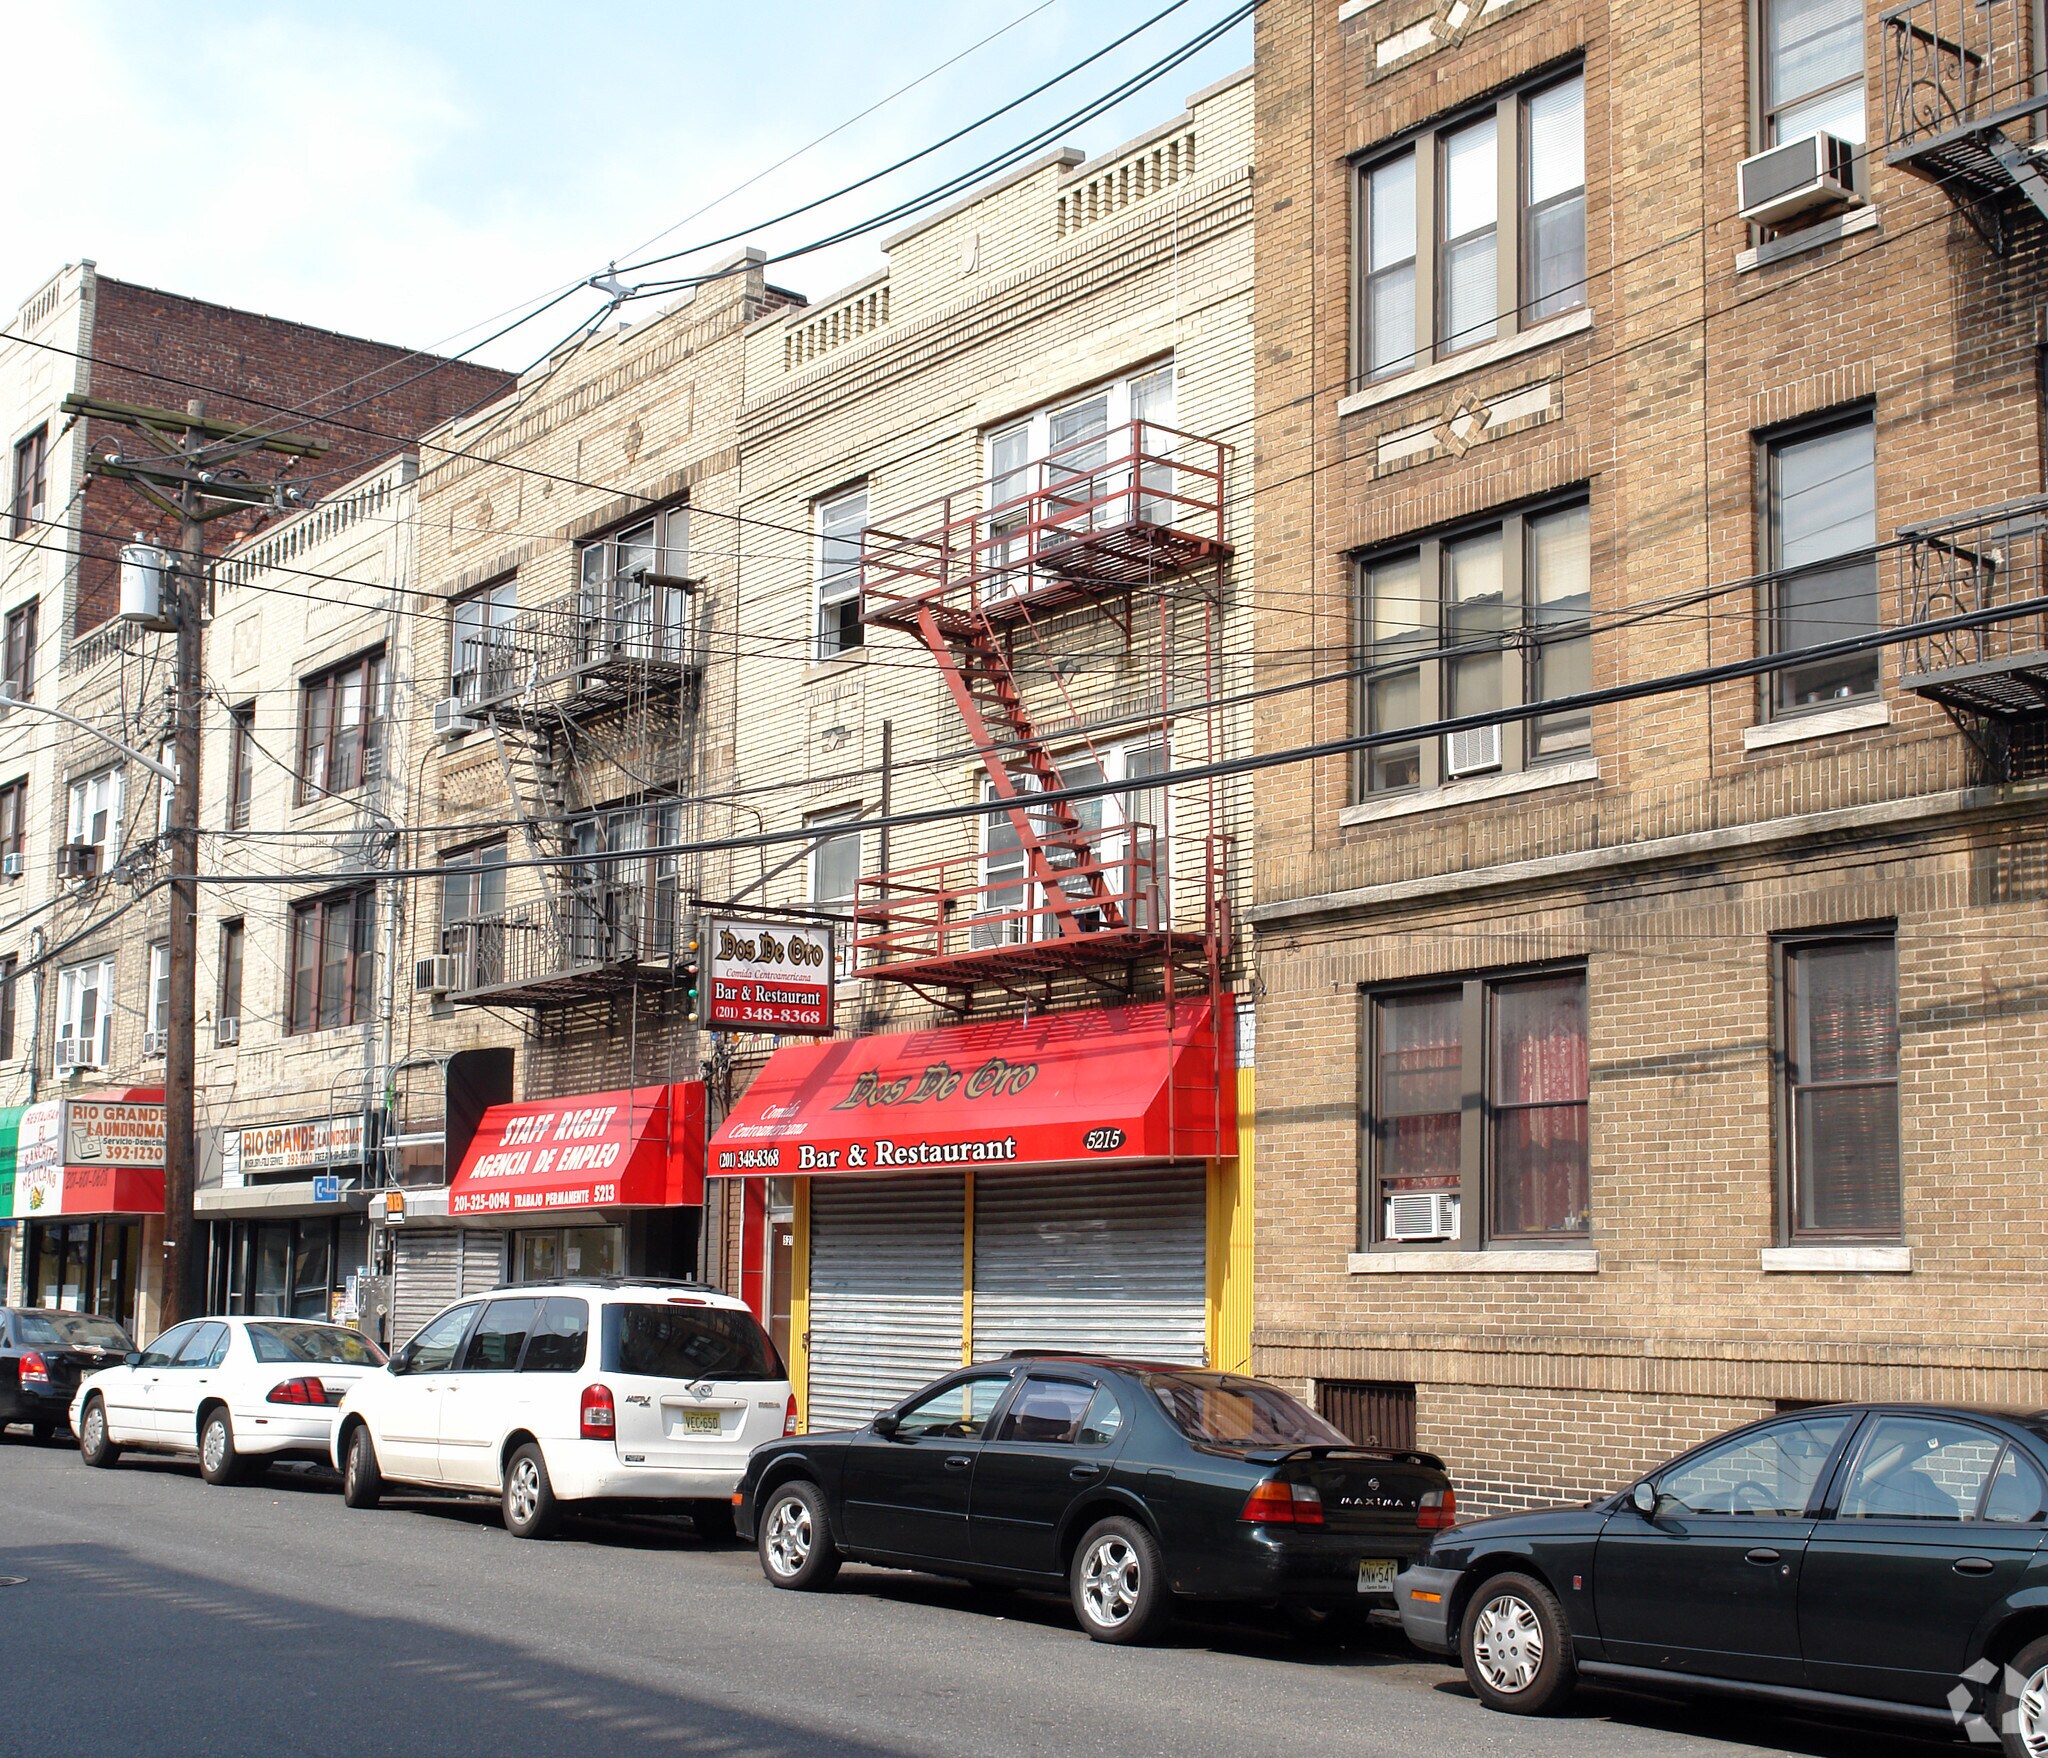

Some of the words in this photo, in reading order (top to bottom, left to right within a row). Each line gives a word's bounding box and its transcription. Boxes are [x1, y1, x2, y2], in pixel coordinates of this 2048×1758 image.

[714, 924, 756, 962] Dos
[752, 930, 785, 964] De
[788, 935, 824, 968] Oro
[726, 968, 752, 978] Comida
[754, 969, 811, 982] Centroamericana
[715, 982, 738, 1000] Bar
[741, 985, 752, 1001] &
[755, 984, 821, 1005] Restaurant
[715, 1006, 739, 1019] (201)
[742, 1007, 820, 1024] 348-8368
[830, 1065, 909, 1112] Dos
[908, 1060, 961, 1105] De
[964, 1058, 1040, 1101] Oro
[72, 1105, 99, 1119] RIO
[103, 1107, 167, 1122] GRANDE
[87, 1122, 165, 1138] LAUNDROMA
[499, 1112, 555, 1147] STAFF
[552, 1106, 617, 1141] RIGHT
[243, 1131, 264, 1157] RIO
[265, 1125, 315, 1155] GRANDE
[1085, 1129, 1123, 1151] 5215
[469, 1149, 529, 1179] AGENCIA
[531, 1148, 558, 1174] DE
[555, 1142, 620, 1172] EMPLEO
[719, 1152, 736, 1169] (201)
[737, 1149, 780, 1168] 348-8368
[798, 1144, 840, 1170] Bar
[846, 1143, 867, 1167] &
[874, 1136, 1018, 1167] Restaurant
[454, 1192, 510, 1212] 201-325-0094
[514, 1193, 543, 1208] TRABAJO
[545, 1189, 589, 1205] PERMANENTE
[593, 1184, 615, 1202] 5213
[1340, 1497, 1404, 1506] MAXIMA
